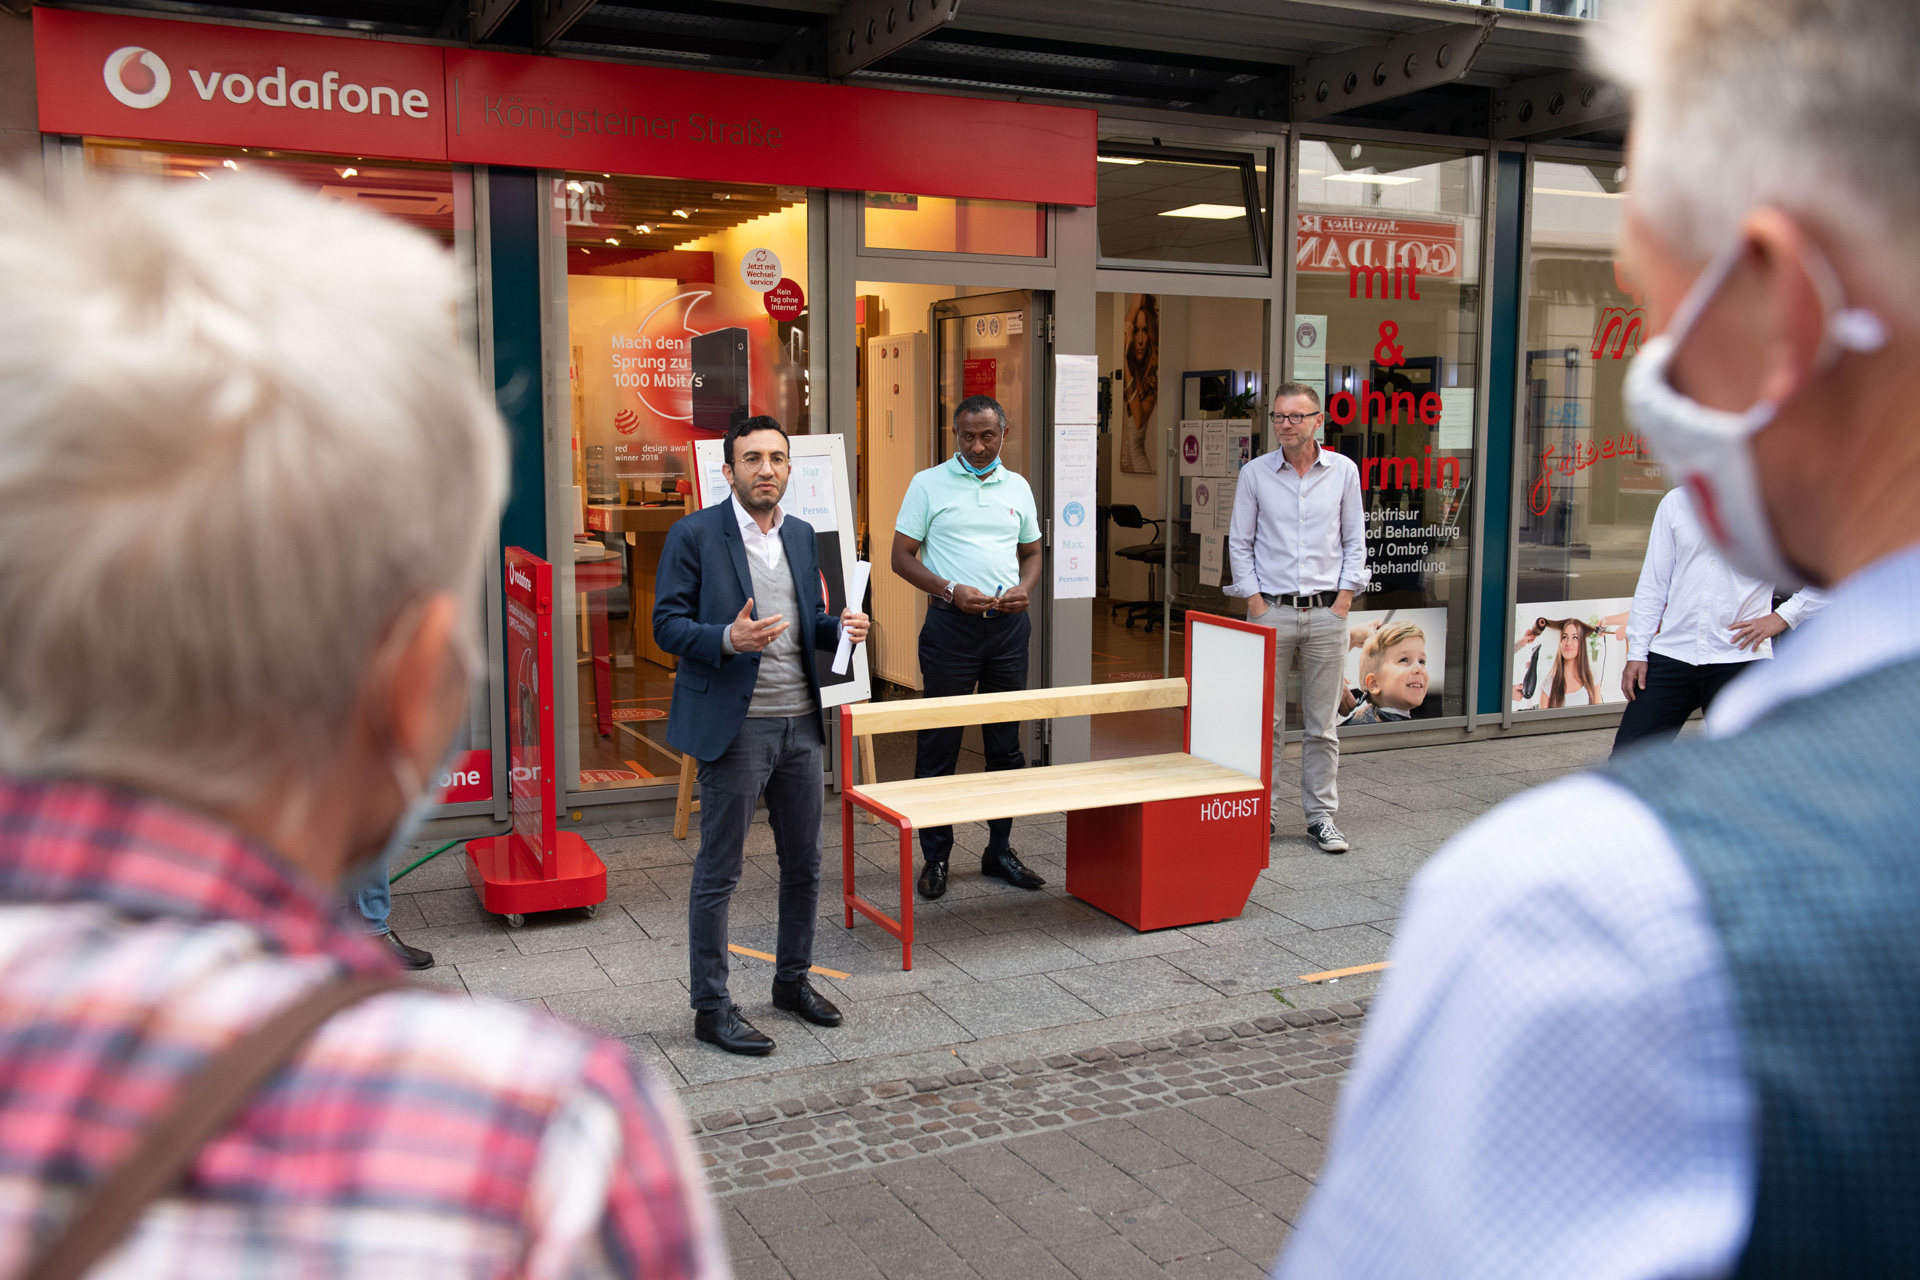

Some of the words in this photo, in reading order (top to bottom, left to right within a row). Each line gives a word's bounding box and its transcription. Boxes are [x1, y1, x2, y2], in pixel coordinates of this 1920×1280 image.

[188, 66, 429, 118] vodafone
[485, 96, 680, 139] Königsteiner
[688, 113, 782, 148] Straße
[1349, 254, 1421, 301] mit
[776, 288, 791, 296] Kein
[769, 296, 781, 304] Tag
[782, 296, 799, 304] ohne
[612, 334, 652, 350] Mach
[656, 335, 684, 350] den
[1373, 319, 1407, 367] &
[612, 354, 666, 372] Sprung
[670, 357, 688, 369] zu
[613, 373, 650, 388] 1000
[1329, 379, 1443, 426] ohne
[642, 444, 668, 454] design
[802, 466, 820, 477] Nur
[1321, 445, 1460, 491] rmin
[810, 485, 817, 497] 1
[802, 507, 829, 516] Person
[1386, 524, 1460, 539] Behandlung
[1062, 540, 1085, 550] Max.
[1387, 542, 1429, 556] Ombré
[1069, 556, 1078, 571] 5
[1208, 550, 1213, 562] 5
[1058, 575, 1090, 583] Personen
[1201, 797, 1261, 822] HÖCHST
